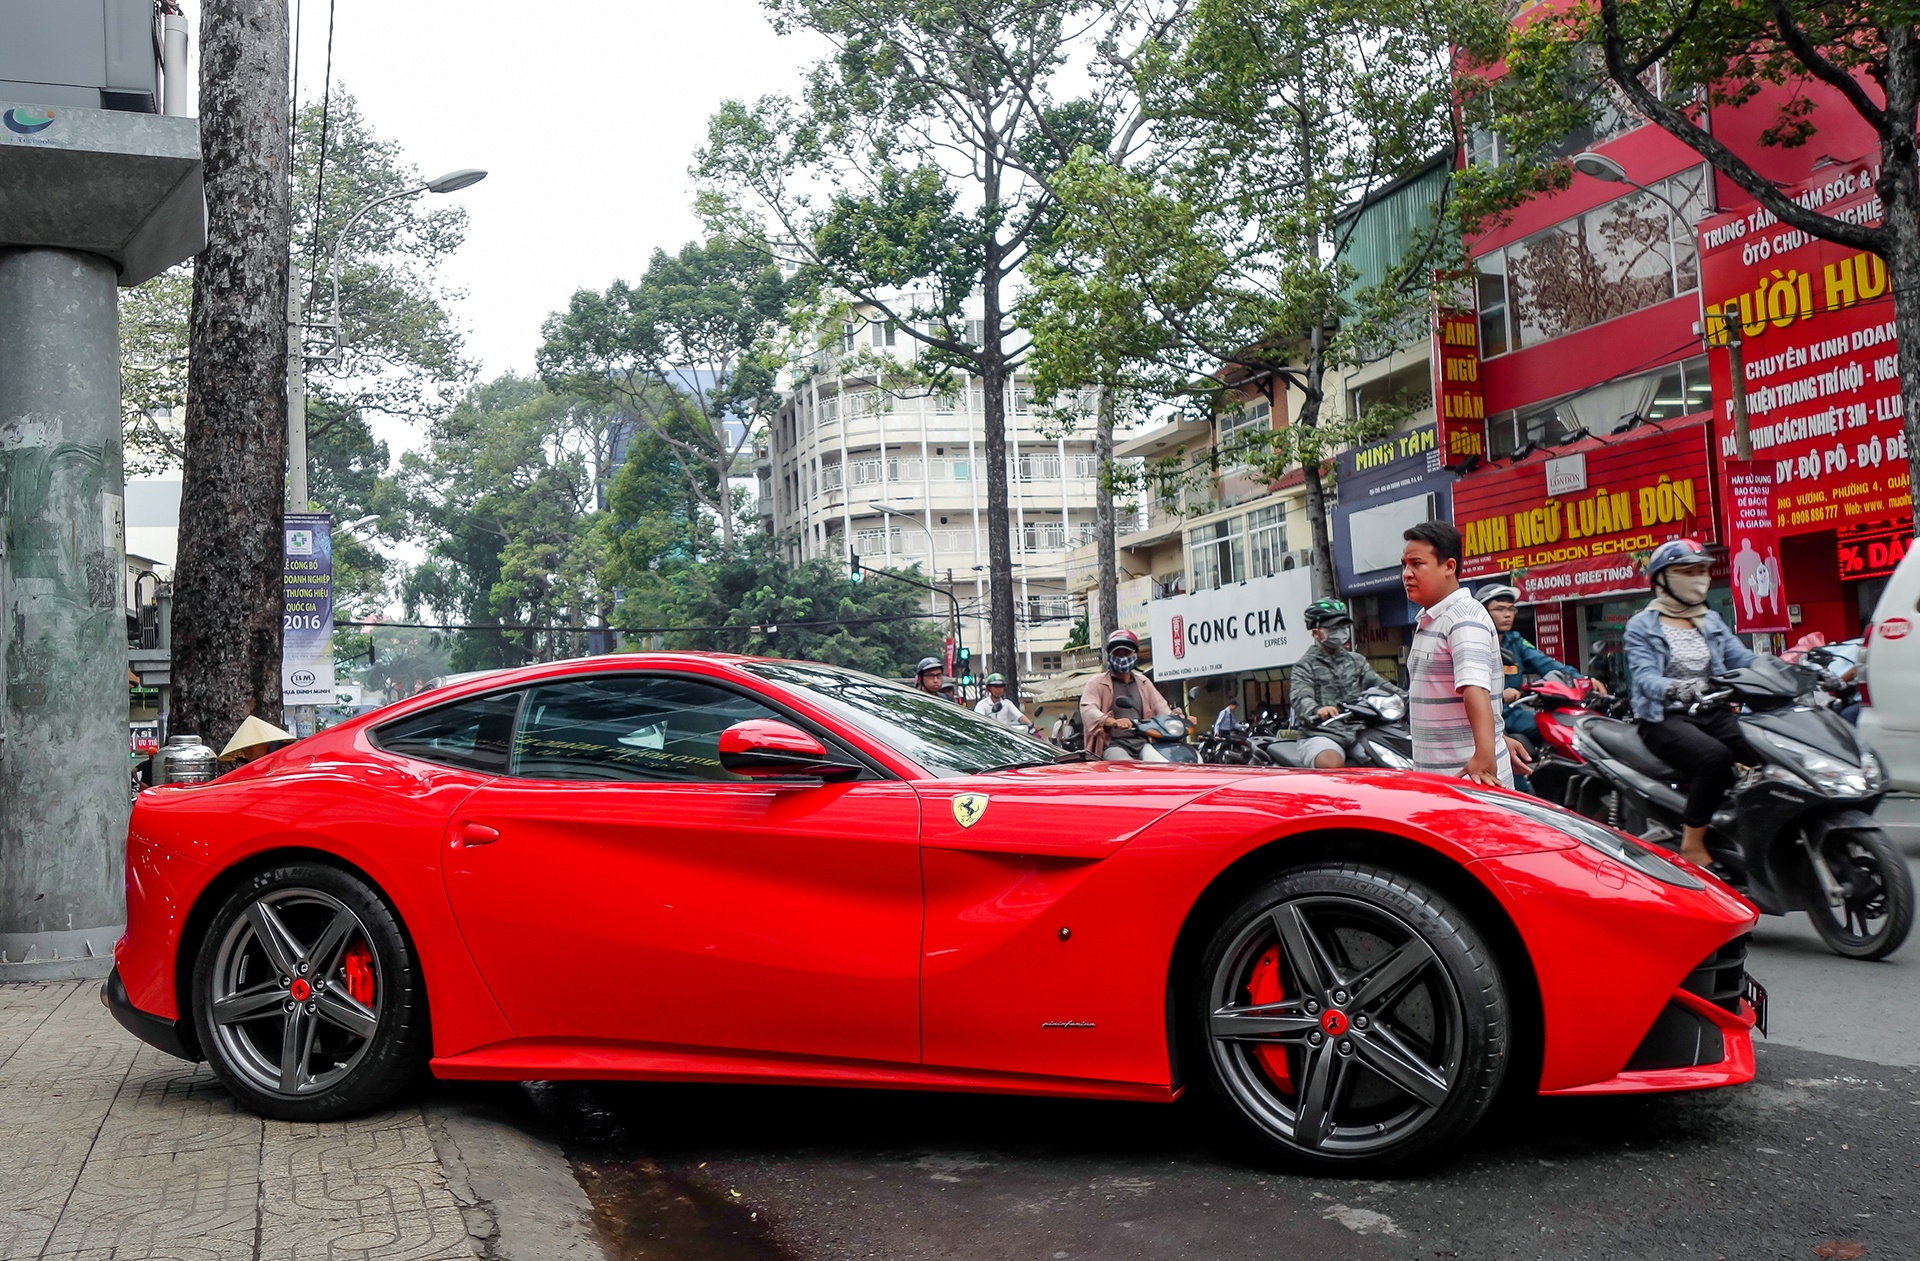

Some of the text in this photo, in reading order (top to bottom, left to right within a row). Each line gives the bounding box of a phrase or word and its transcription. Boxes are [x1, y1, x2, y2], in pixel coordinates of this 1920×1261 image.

[1703, 219, 1746, 250] TRUNG
[1748, 206, 1778, 233] TÂM
[1825, 173, 1856, 203] SÓC
[1742, 236, 1771, 266] ÔTÔ
[1833, 193, 1883, 225] NGHIỆ
[1823, 252, 1892, 312] HU
[1445, 321, 1476, 346] ANH
[1745, 320, 1898, 381] CHUYÊN KINH DOAN
[1750, 385, 1777, 415] KIỆN
[1776, 376, 1818, 408] TRANG
[1817, 365, 1839, 397] TRÍ
[1839, 360, 1864, 393] NỘI
[1445, 391, 1484, 419] LUÂN
[1749, 425, 1775, 450] HIM
[1775, 416, 1807, 445] CÁCH
[1808, 405, 1845, 437] NHIỆT
[1846, 402, 1868, 428] 3M
[1876, 394, 1904, 421] LLU
[1355, 443, 1395, 471] MINH
[1399, 429, 1435, 458] TÂM
[1825, 442, 1848, 475] PÔ
[1857, 434, 1882, 468] ĐỘ
[1886, 429, 1909, 461] ĐÈ
[1550, 474, 1580, 487] LONDON
[1734, 486, 1748, 496] BAO
[1465, 515, 1509, 557] ANH
[1566, 488, 1633, 539] LUÂN
[1740, 508, 1755, 518] CHO
[1746, 519, 1758, 529] GIA
[1791, 509, 1809, 525] 0908
[1825, 503, 1838, 520] 777
[290, 559, 308, 570] CÔNG
[1497, 554, 1525, 571] THE
[1528, 545, 1589, 566] LONDON
[1592, 533, 1660, 556] SCHOOL
[284, 575, 306, 584] DOANH
[1574, 565, 1634, 585] GREETINGS
[305, 602, 316, 612] GIA
[284, 614, 320, 629] 2016
[1188, 607, 1287, 646] GONG CHA
[1264, 636, 1288, 648] EXPRESS
